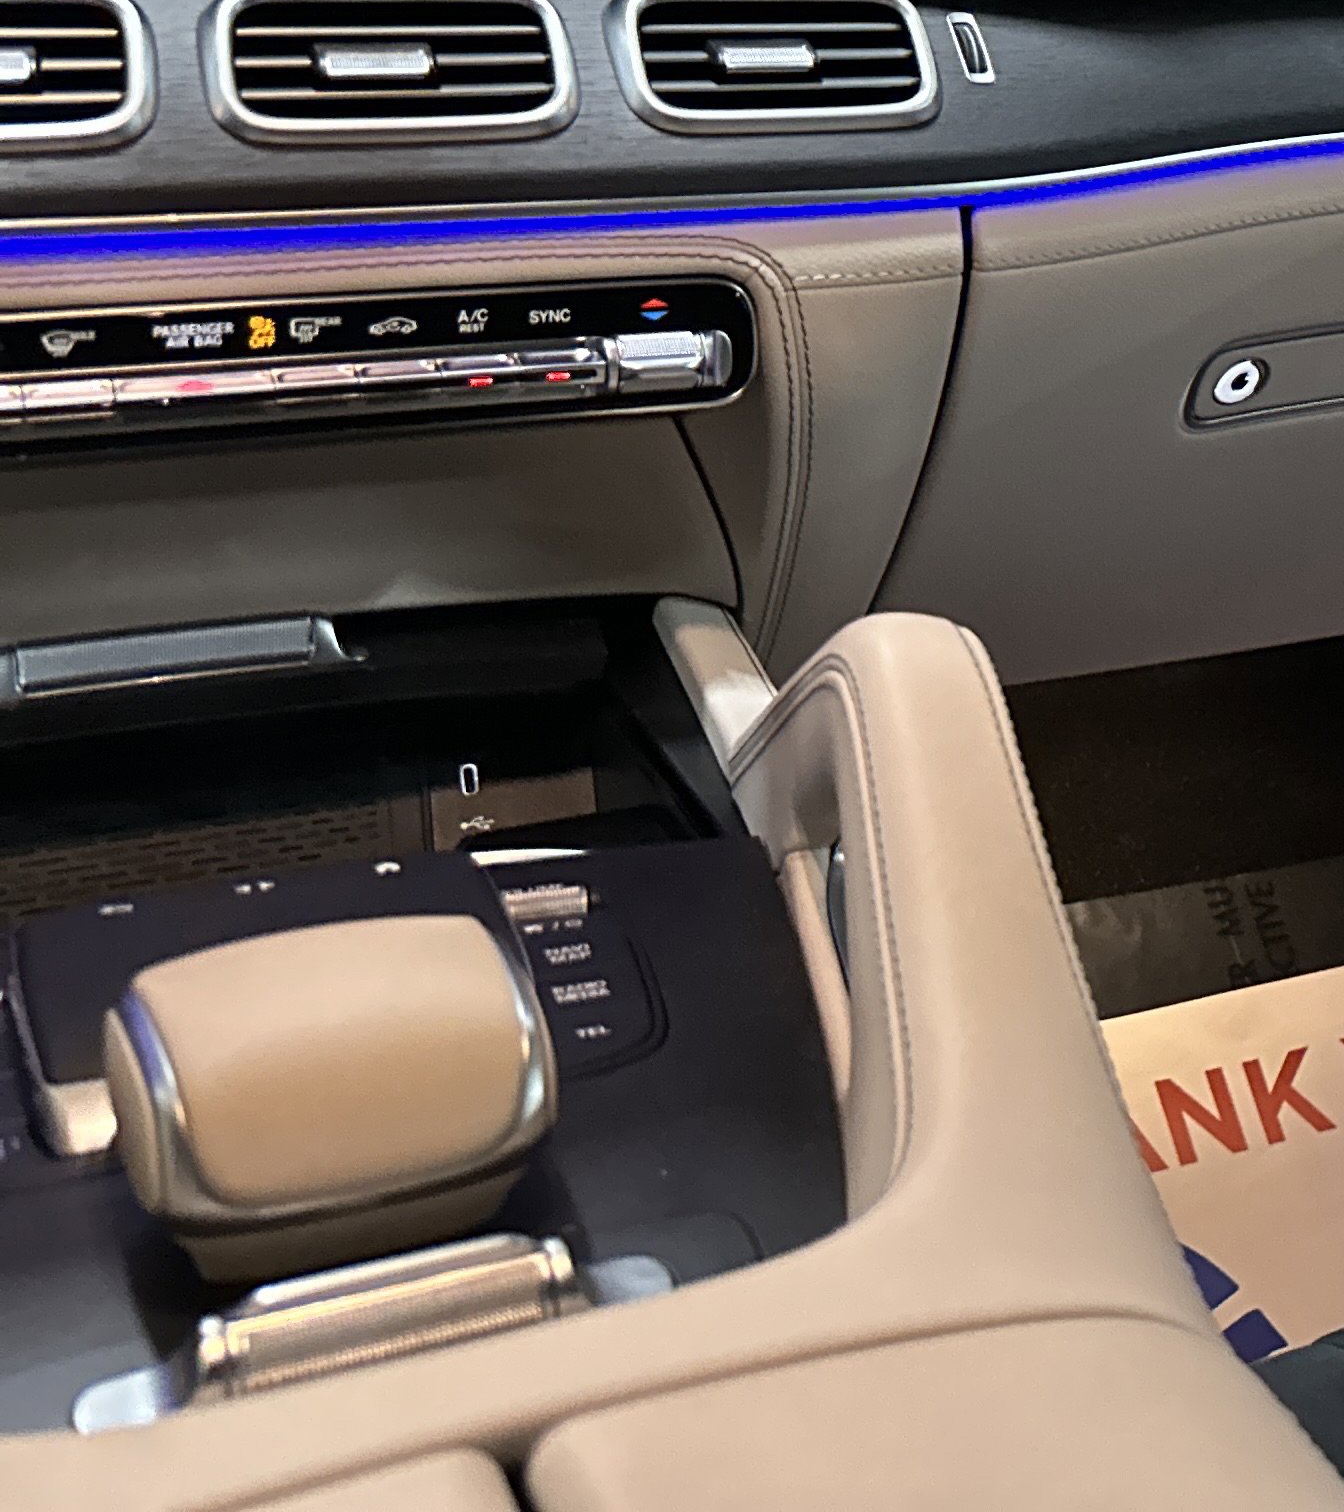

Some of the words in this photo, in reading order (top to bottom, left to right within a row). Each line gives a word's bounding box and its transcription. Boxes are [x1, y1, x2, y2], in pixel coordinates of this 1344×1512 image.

[458, 308, 489, 323] A/C
[529, 308, 571, 325] SYNC
[152, 322, 234, 338] PASSENGER
[165, 335, 190, 348] AIR
[194, 334, 222, 347] BAG
